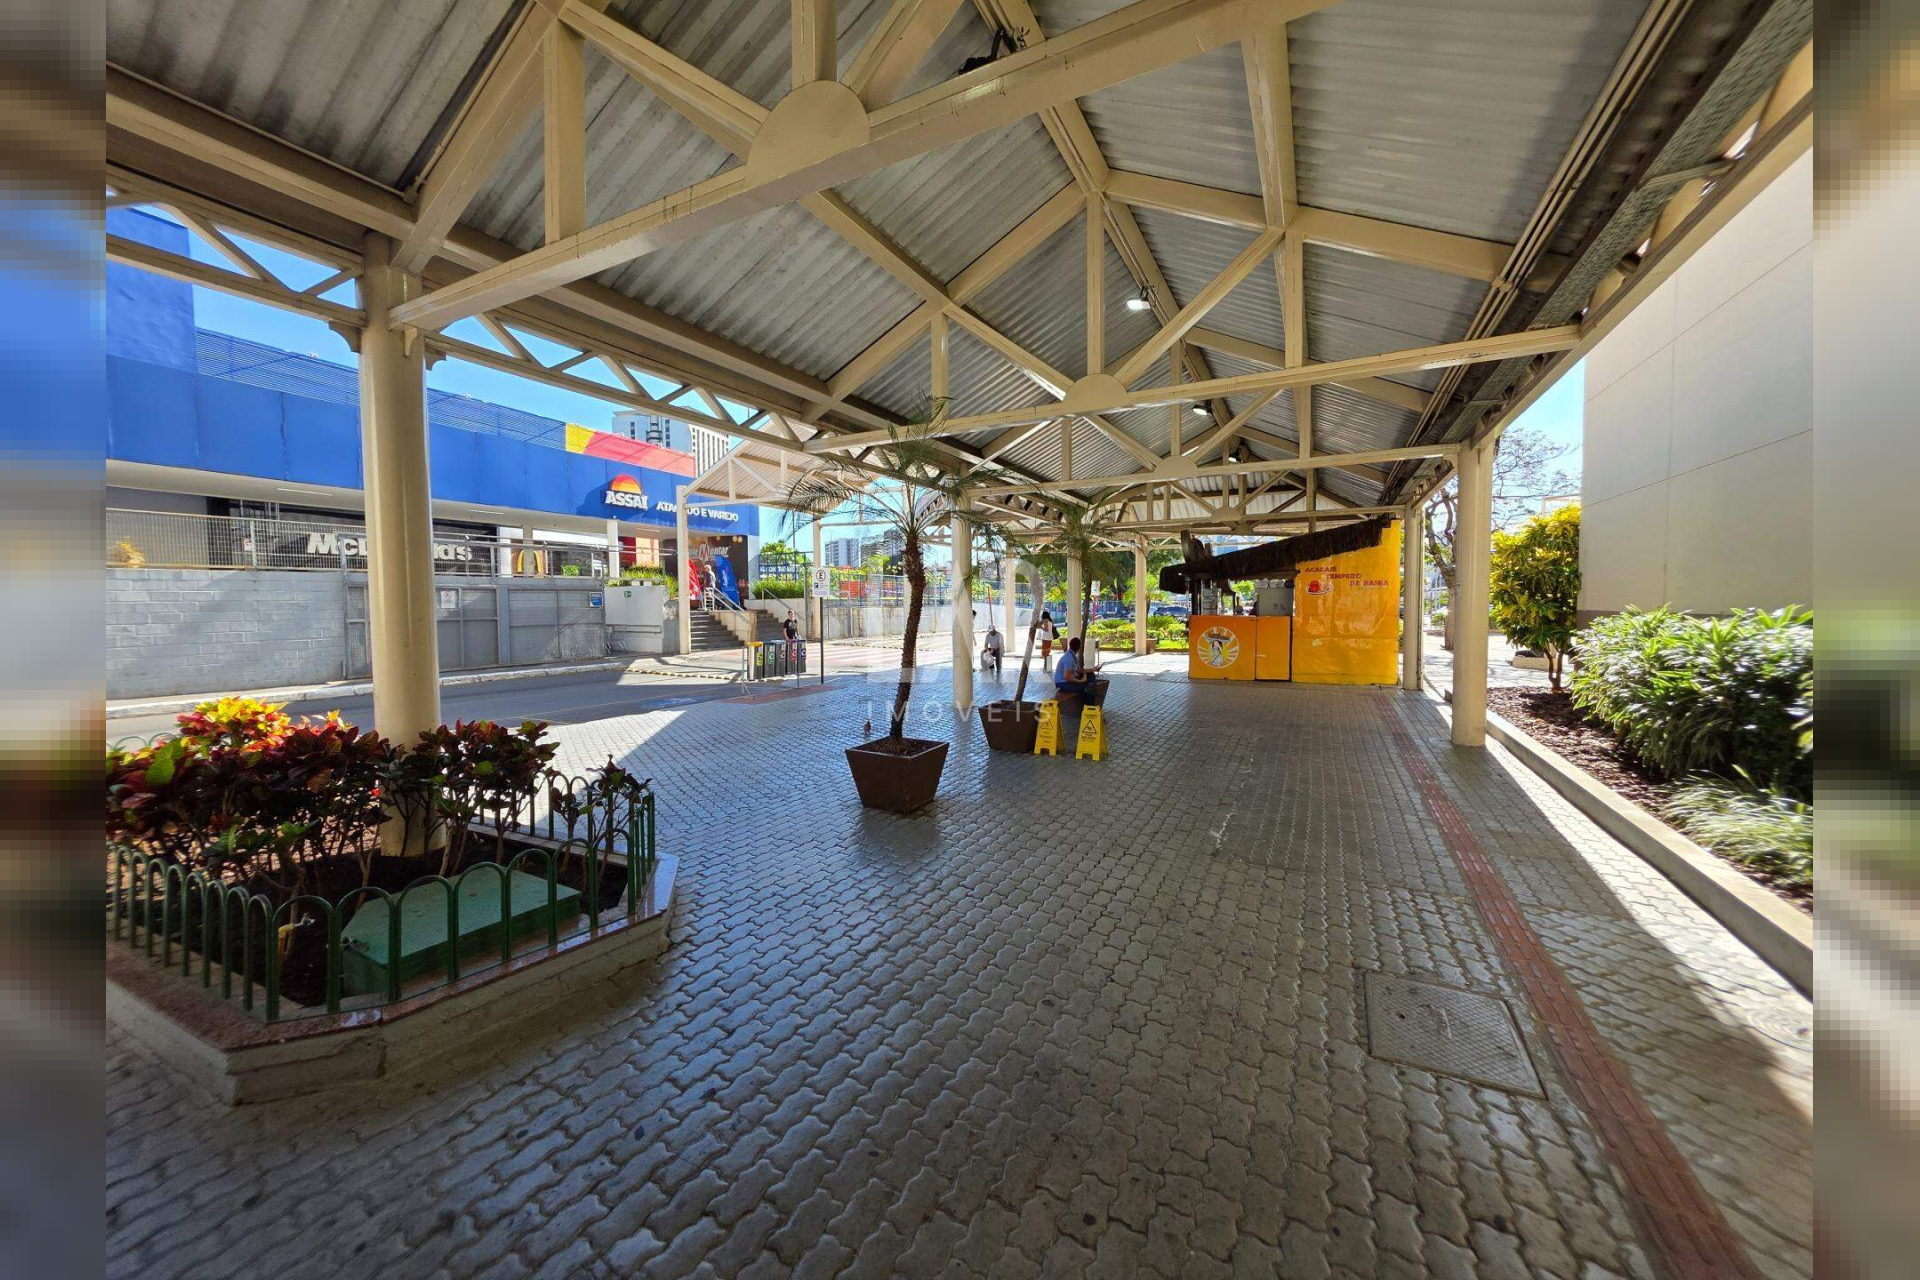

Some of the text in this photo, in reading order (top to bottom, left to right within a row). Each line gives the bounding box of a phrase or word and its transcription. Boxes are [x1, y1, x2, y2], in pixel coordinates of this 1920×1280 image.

[656, 501, 739, 522] ATADO E VAREJO
